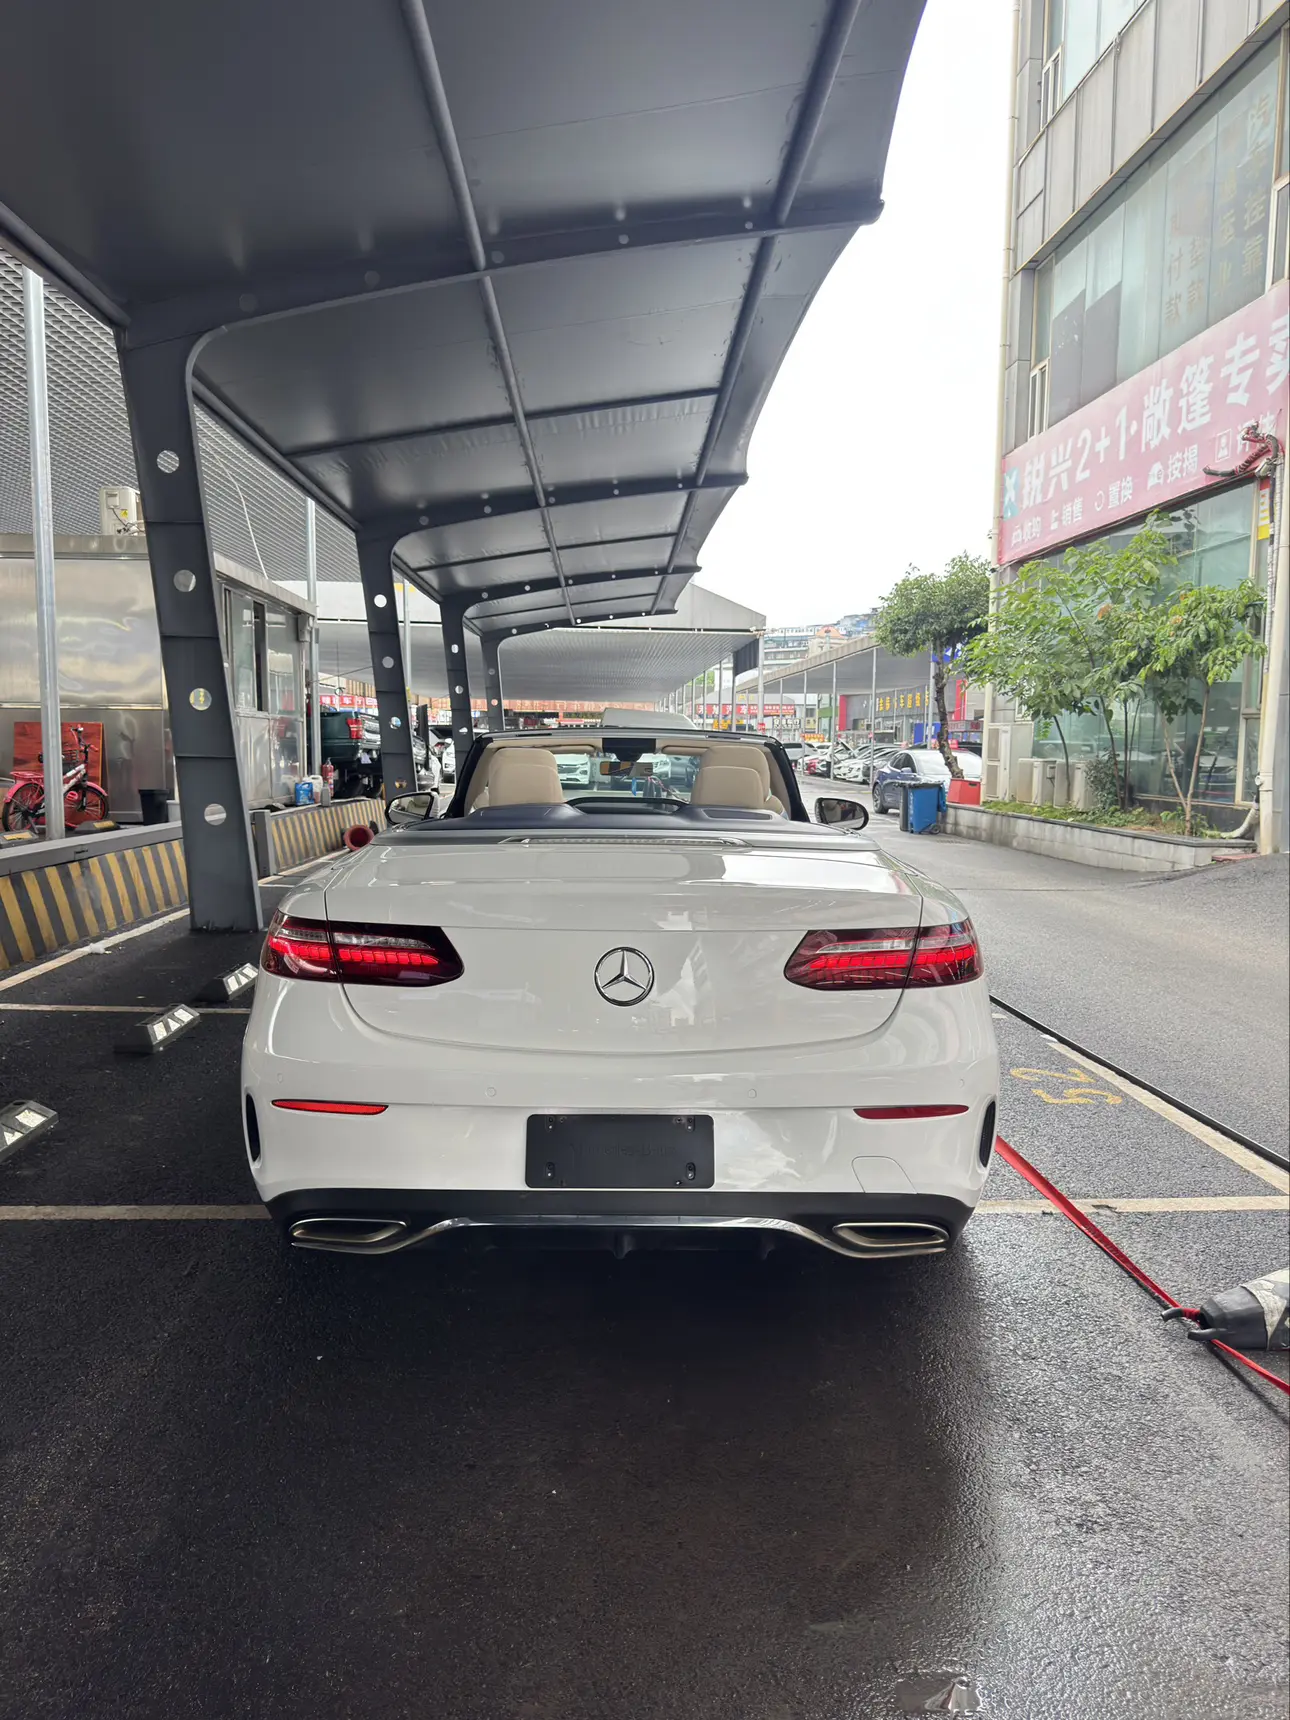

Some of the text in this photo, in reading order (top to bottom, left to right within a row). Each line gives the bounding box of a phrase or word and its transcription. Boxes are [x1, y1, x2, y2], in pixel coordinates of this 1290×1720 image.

[1062, 496, 1083, 526] 销售
[1108, 475, 1133, 509] 置换
[1167, 443, 1198, 483] 按揭
